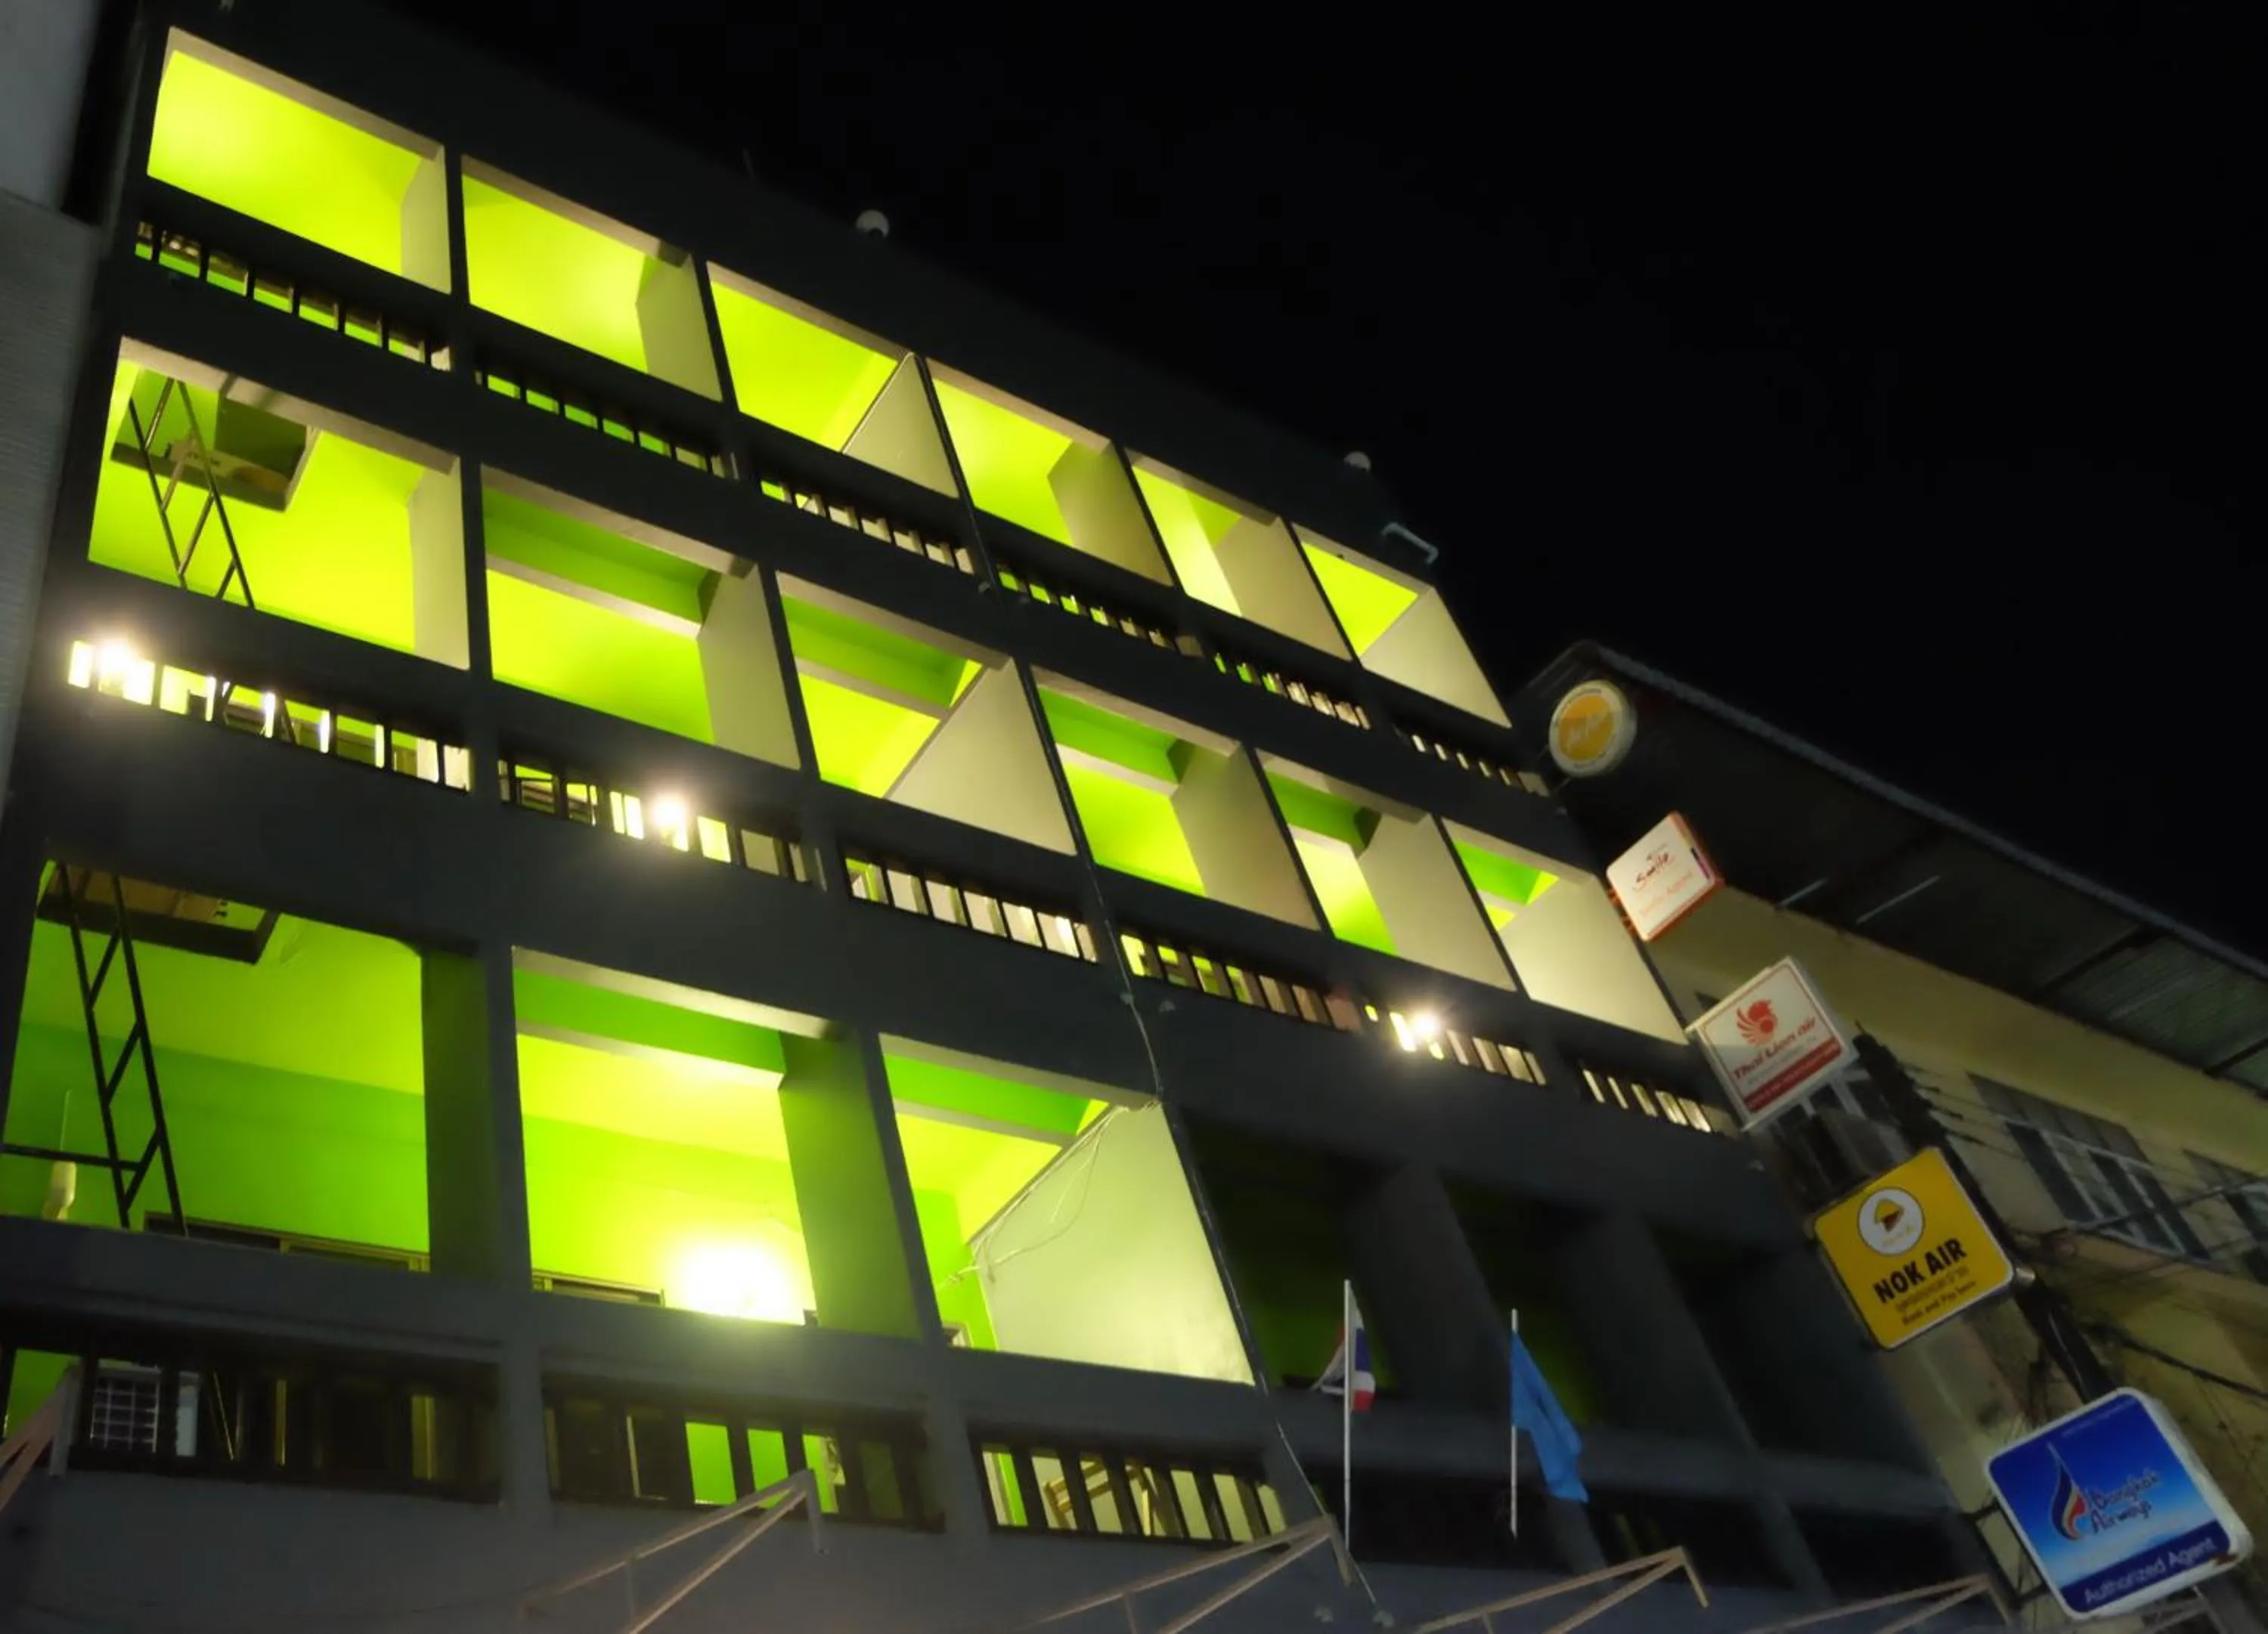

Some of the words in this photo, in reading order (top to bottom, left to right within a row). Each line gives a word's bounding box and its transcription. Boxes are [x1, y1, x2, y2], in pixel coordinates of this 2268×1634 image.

[1873, 1261, 1926, 1304] NOK
[1925, 1238, 1967, 1275] AIR
[2084, 1557, 2166, 1604] Authorized
[2168, 1537, 2215, 1568] Agent
